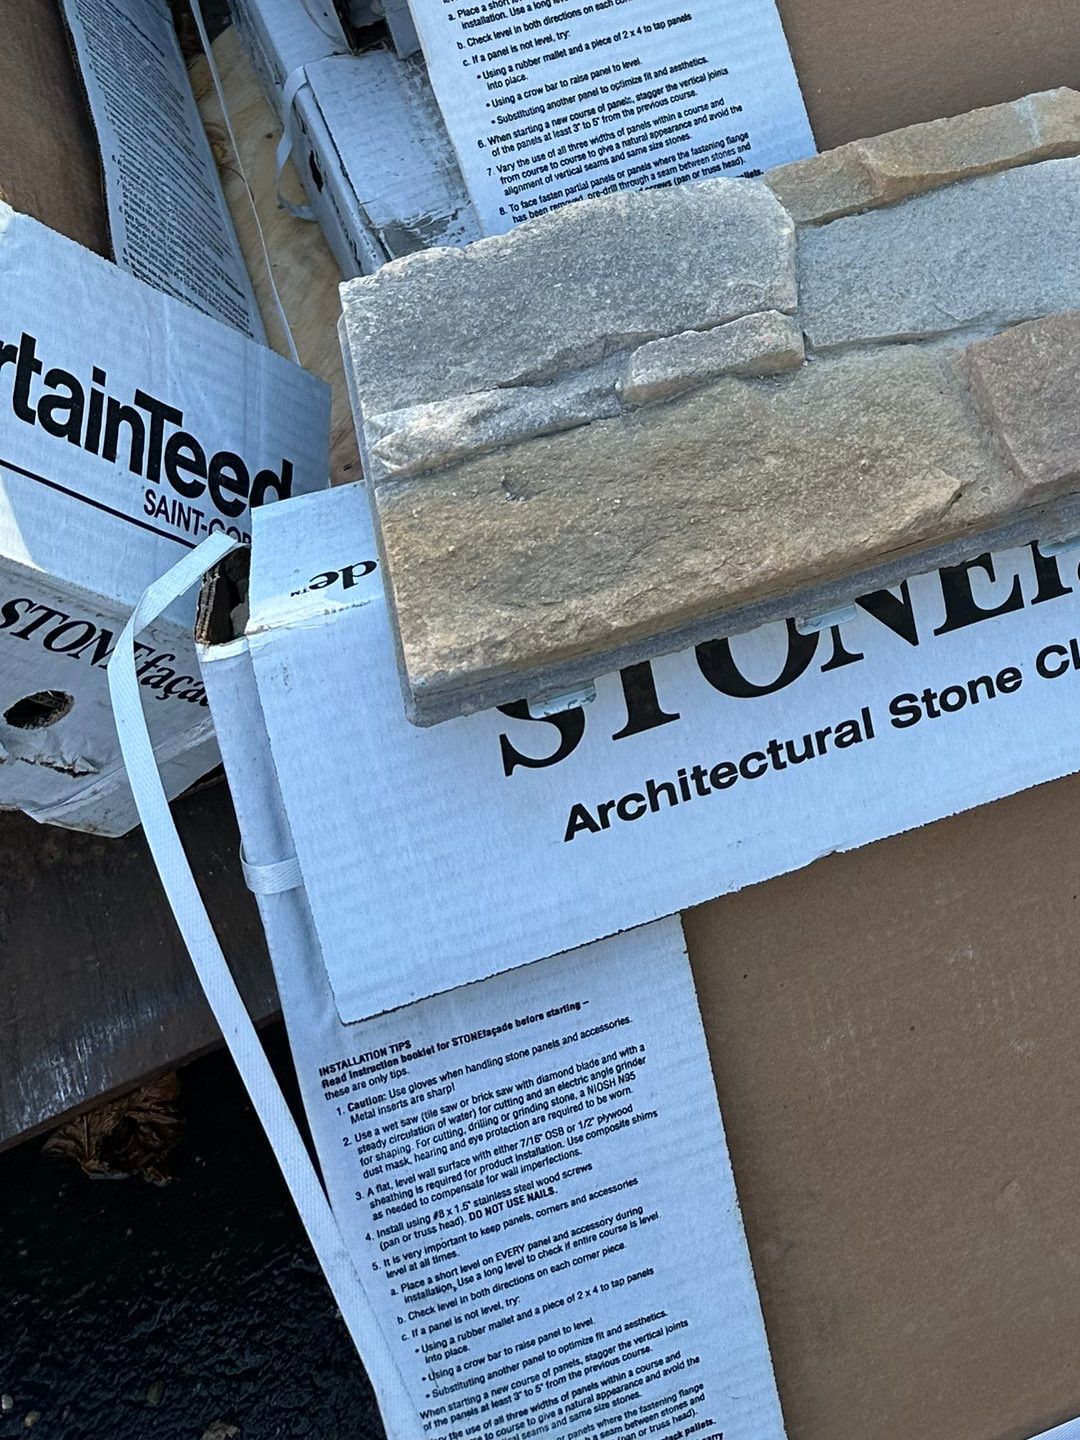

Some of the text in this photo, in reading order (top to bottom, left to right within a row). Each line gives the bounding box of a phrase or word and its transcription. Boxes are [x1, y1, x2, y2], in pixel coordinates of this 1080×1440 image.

[563, 706, 876, 842] Architectural
[888, 665, 1023, 729] Stone
[318, 1040, 411, 1076] INSTALLATION TIPS
